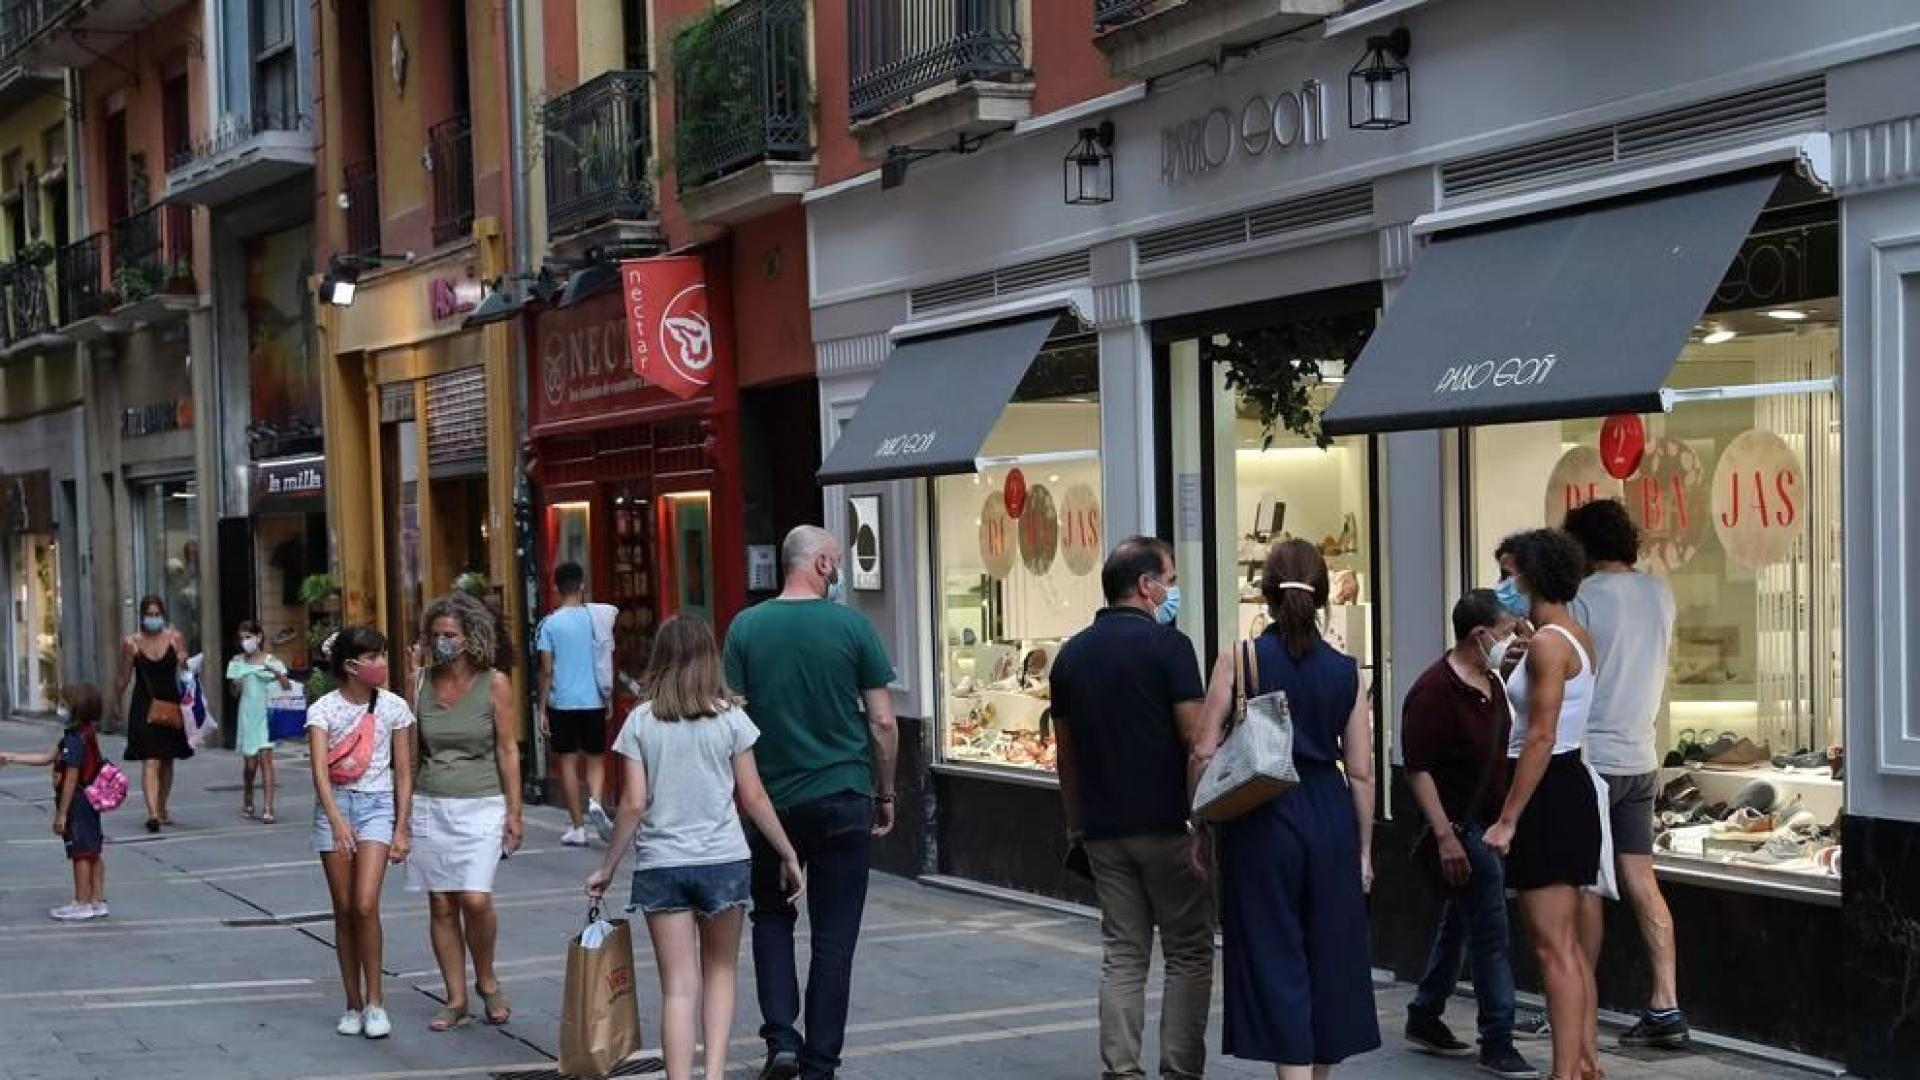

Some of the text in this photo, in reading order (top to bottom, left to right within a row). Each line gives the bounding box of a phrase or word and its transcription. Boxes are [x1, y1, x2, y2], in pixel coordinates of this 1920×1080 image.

[568, 318, 633, 379] NECT
[629, 270, 648, 370] nectar
[1720, 468, 1798, 530] JAS
